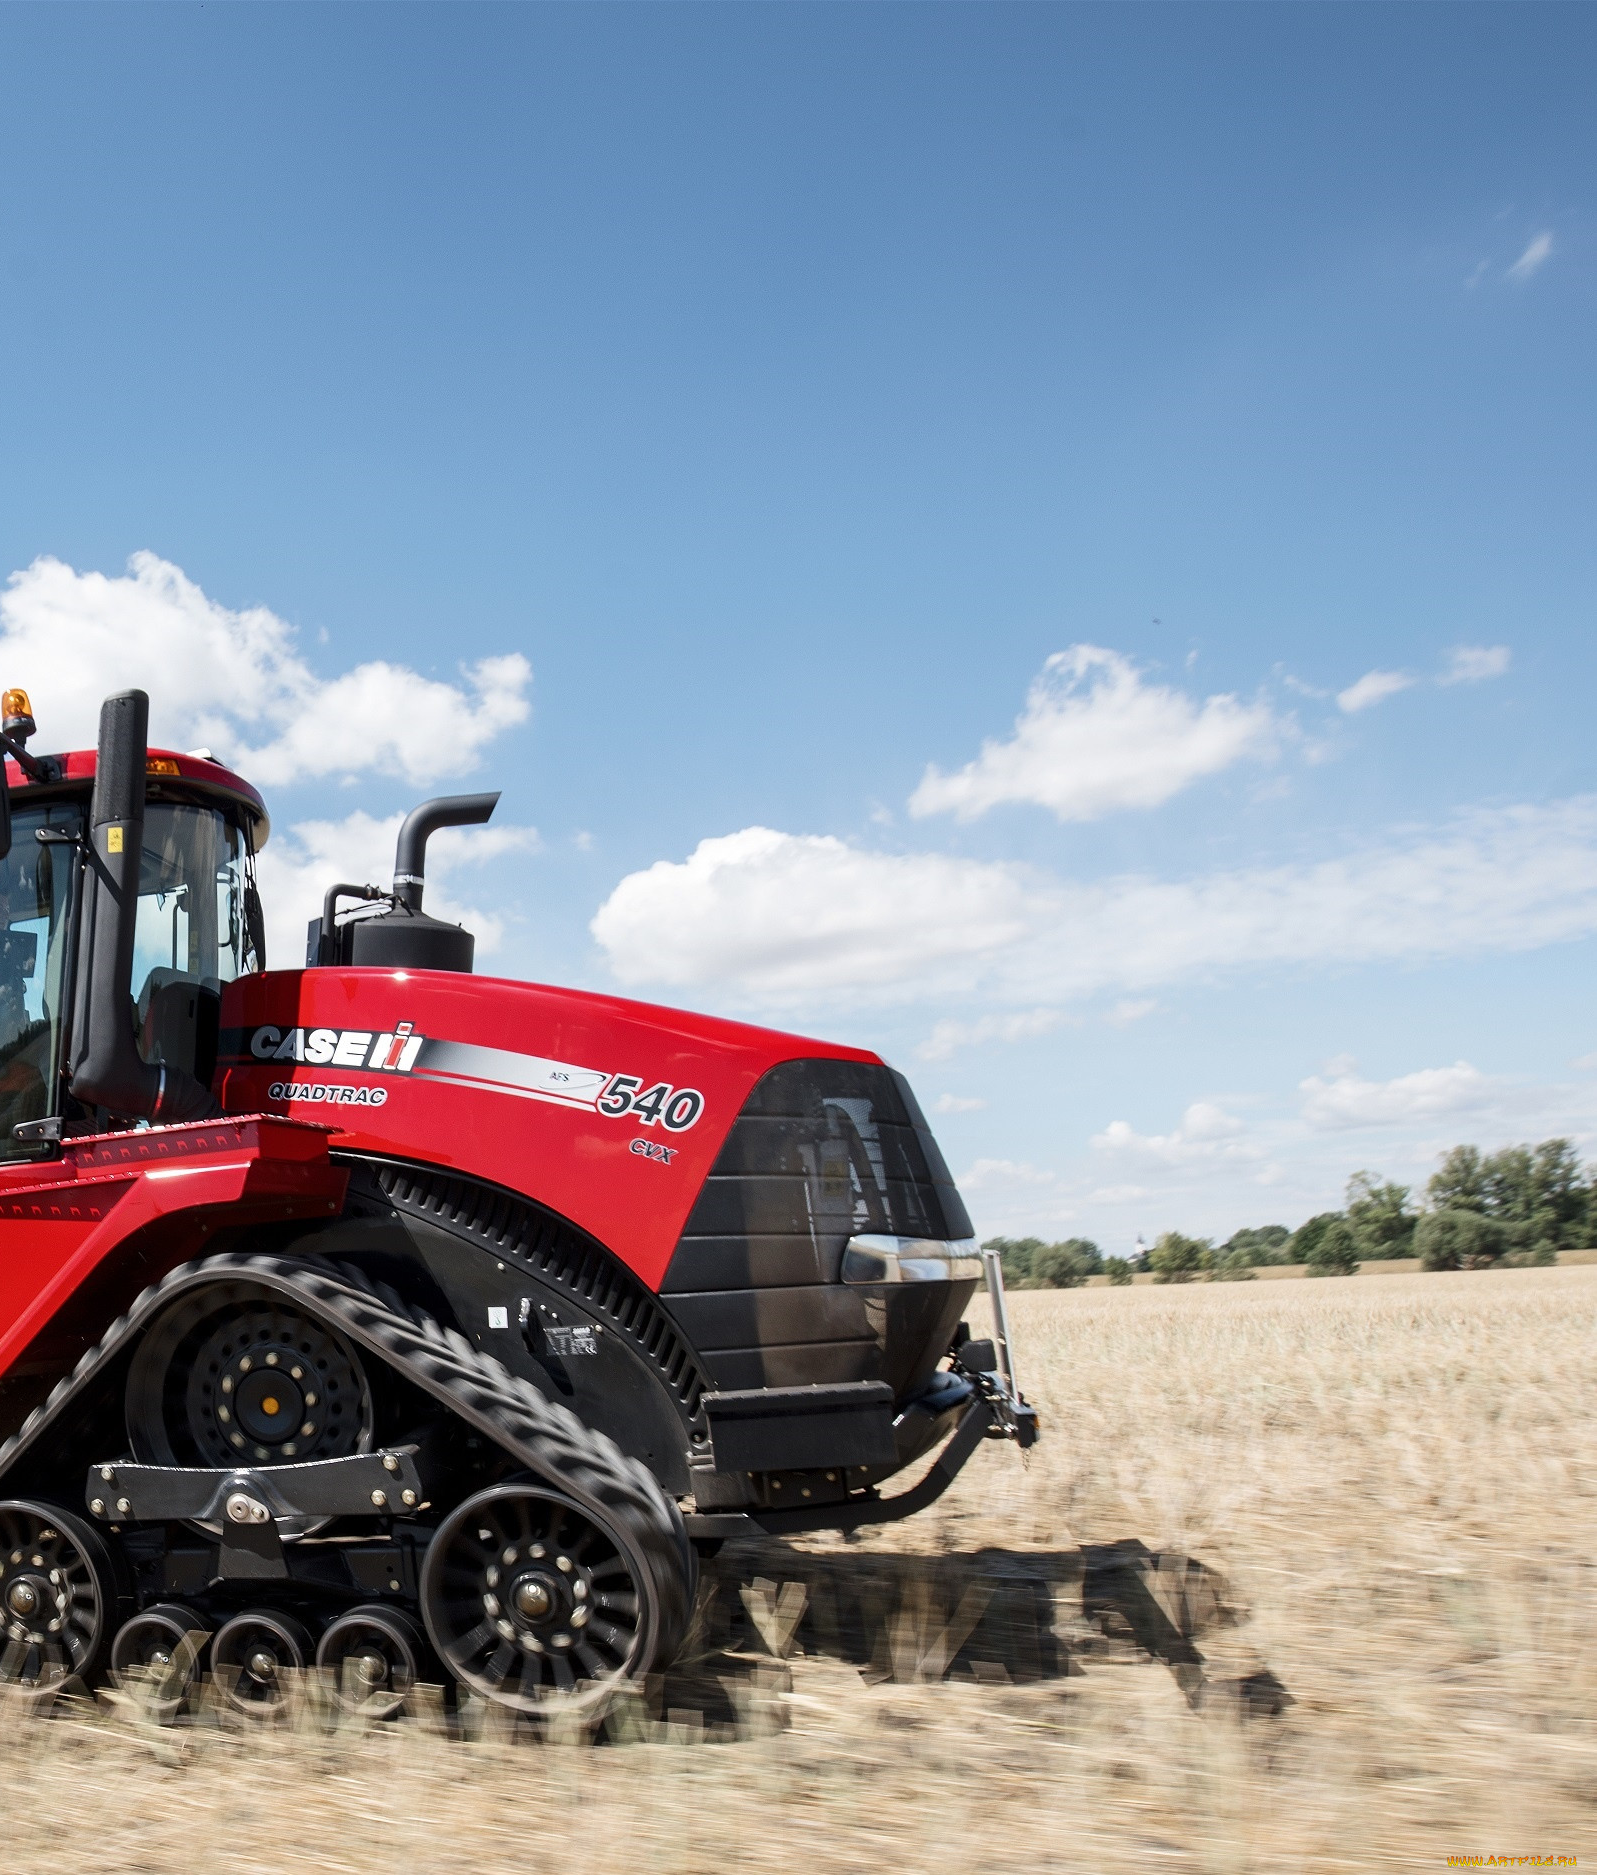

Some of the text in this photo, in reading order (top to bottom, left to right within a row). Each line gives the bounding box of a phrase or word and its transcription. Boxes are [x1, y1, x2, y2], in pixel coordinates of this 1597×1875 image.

[250, 1025, 373, 1067] CASE
[268, 1082, 388, 1107] QUADTRAC
[597, 1073, 705, 1133] 540
[629, 1138, 679, 1165] CVX
